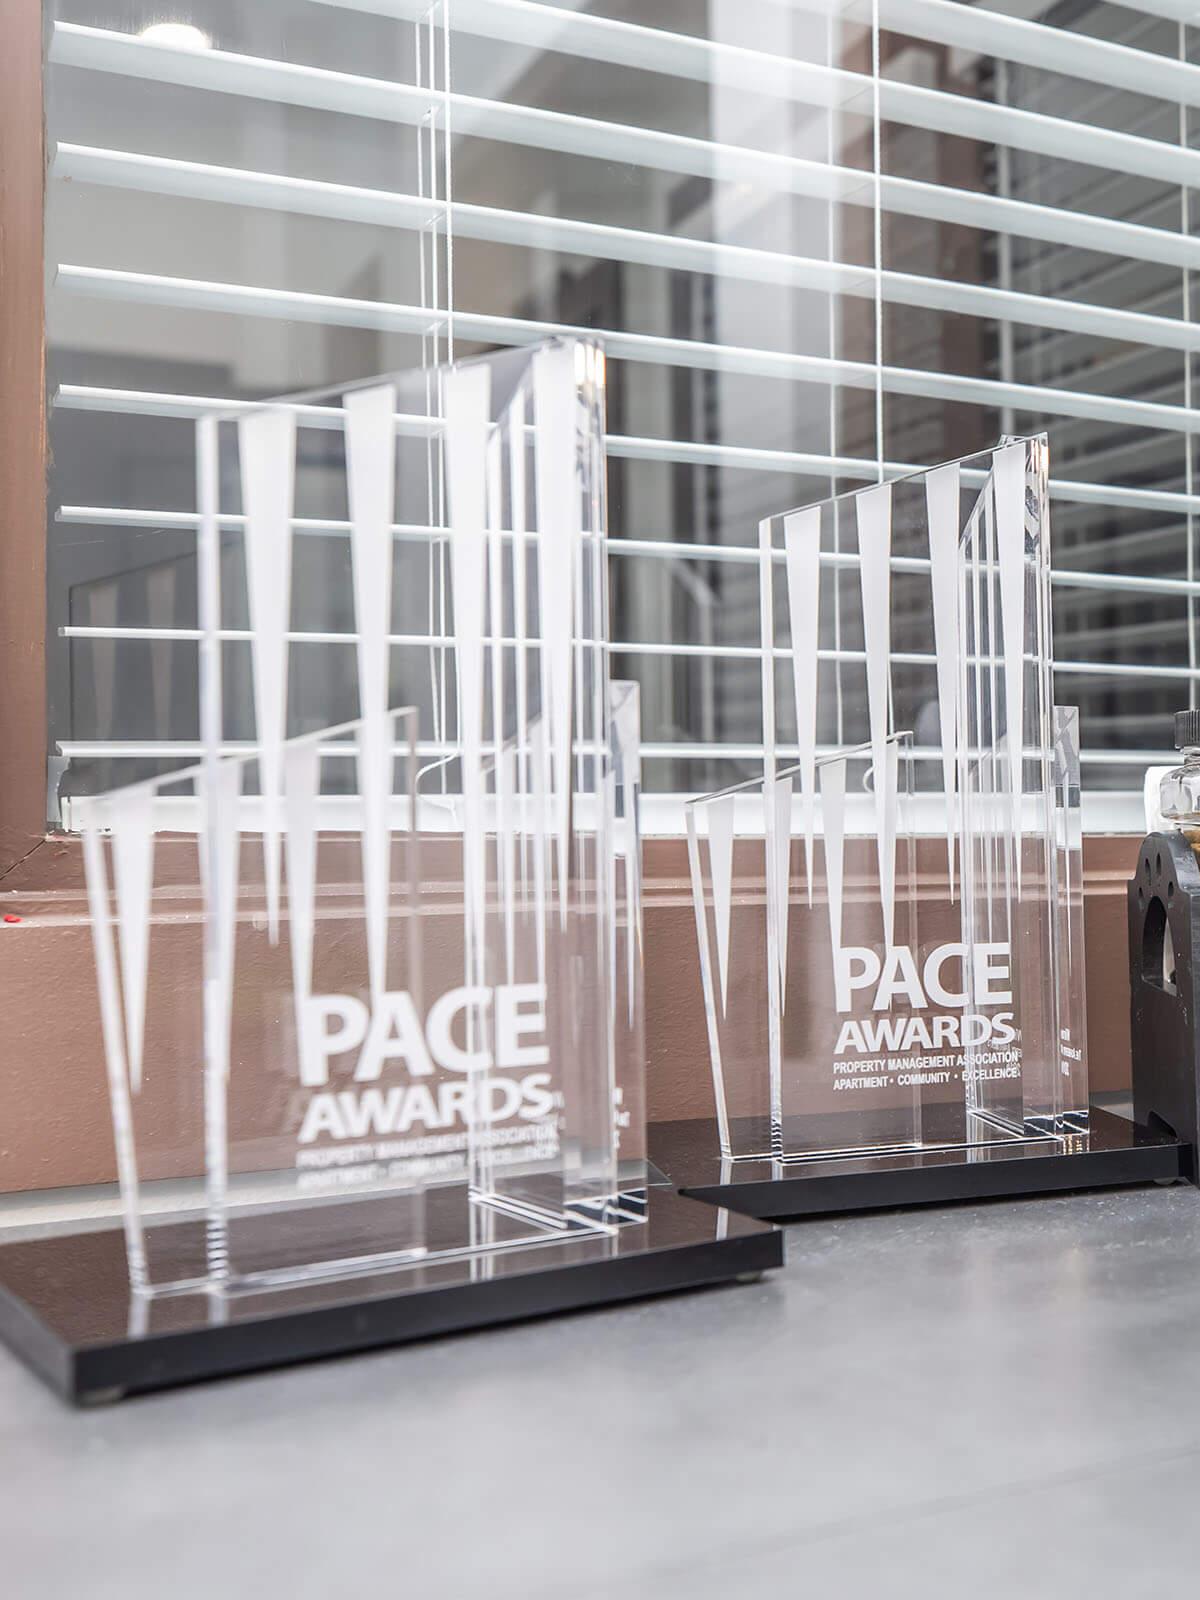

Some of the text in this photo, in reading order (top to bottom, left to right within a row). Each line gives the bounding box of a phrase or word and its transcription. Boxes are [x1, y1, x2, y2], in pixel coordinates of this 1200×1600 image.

[834, 942, 1013, 1013] PACE
[299, 983, 551, 1087] PACE
[834, 1012, 1016, 1055] AWARDS
[833, 1051, 1018, 1075] PROPERTY MANAGEMENT ASSOCIATION
[833, 1067, 1019, 1091] APARTMENT COMMUNITY EXCELLENCE
[297, 1072, 552, 1144] AWARDS
